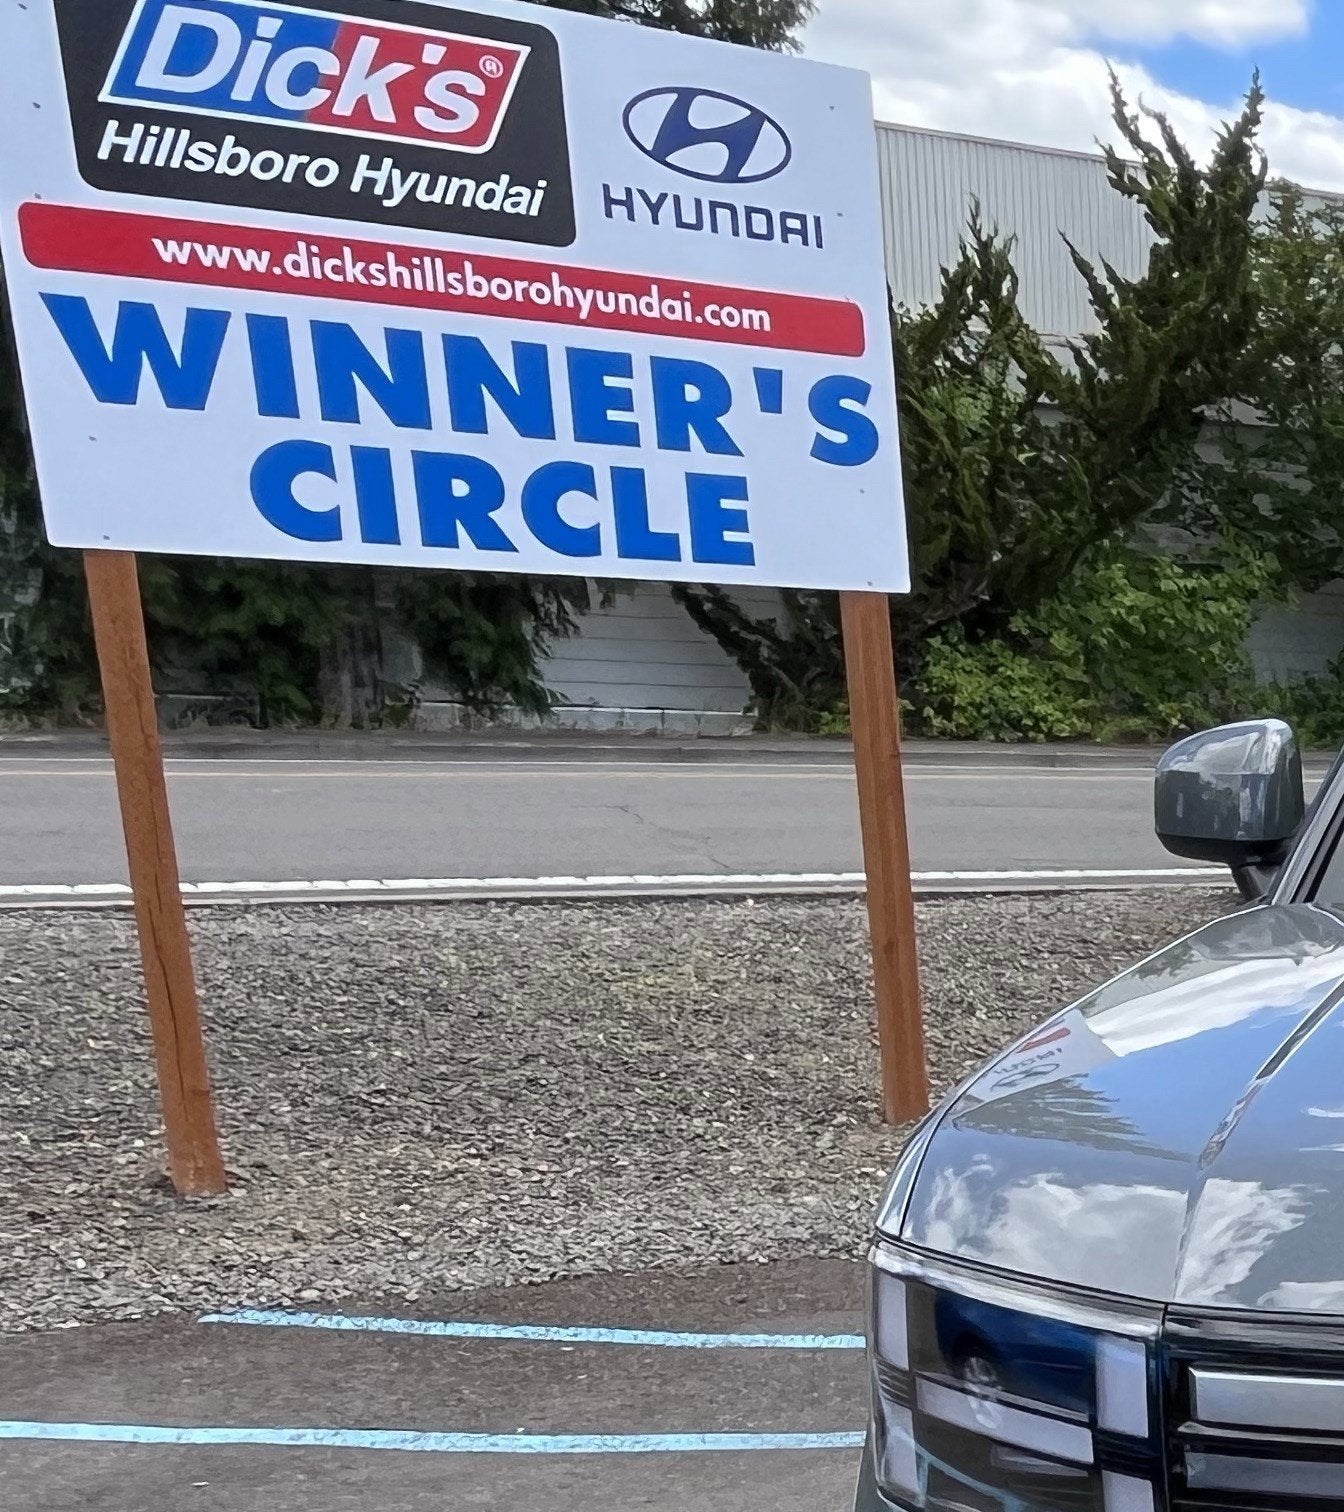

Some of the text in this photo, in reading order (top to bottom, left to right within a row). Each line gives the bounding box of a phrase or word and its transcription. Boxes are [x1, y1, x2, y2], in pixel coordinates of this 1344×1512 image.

[97, 120, 548, 217] Hillsboro Hyundai
[602, 184, 824, 249] HYUNDAI
[151, 232, 772, 334] www.dickshillsborohyundai.com
[38, 291, 880, 467] WINNER'S
[249, 438, 757, 567] CIRCLE
